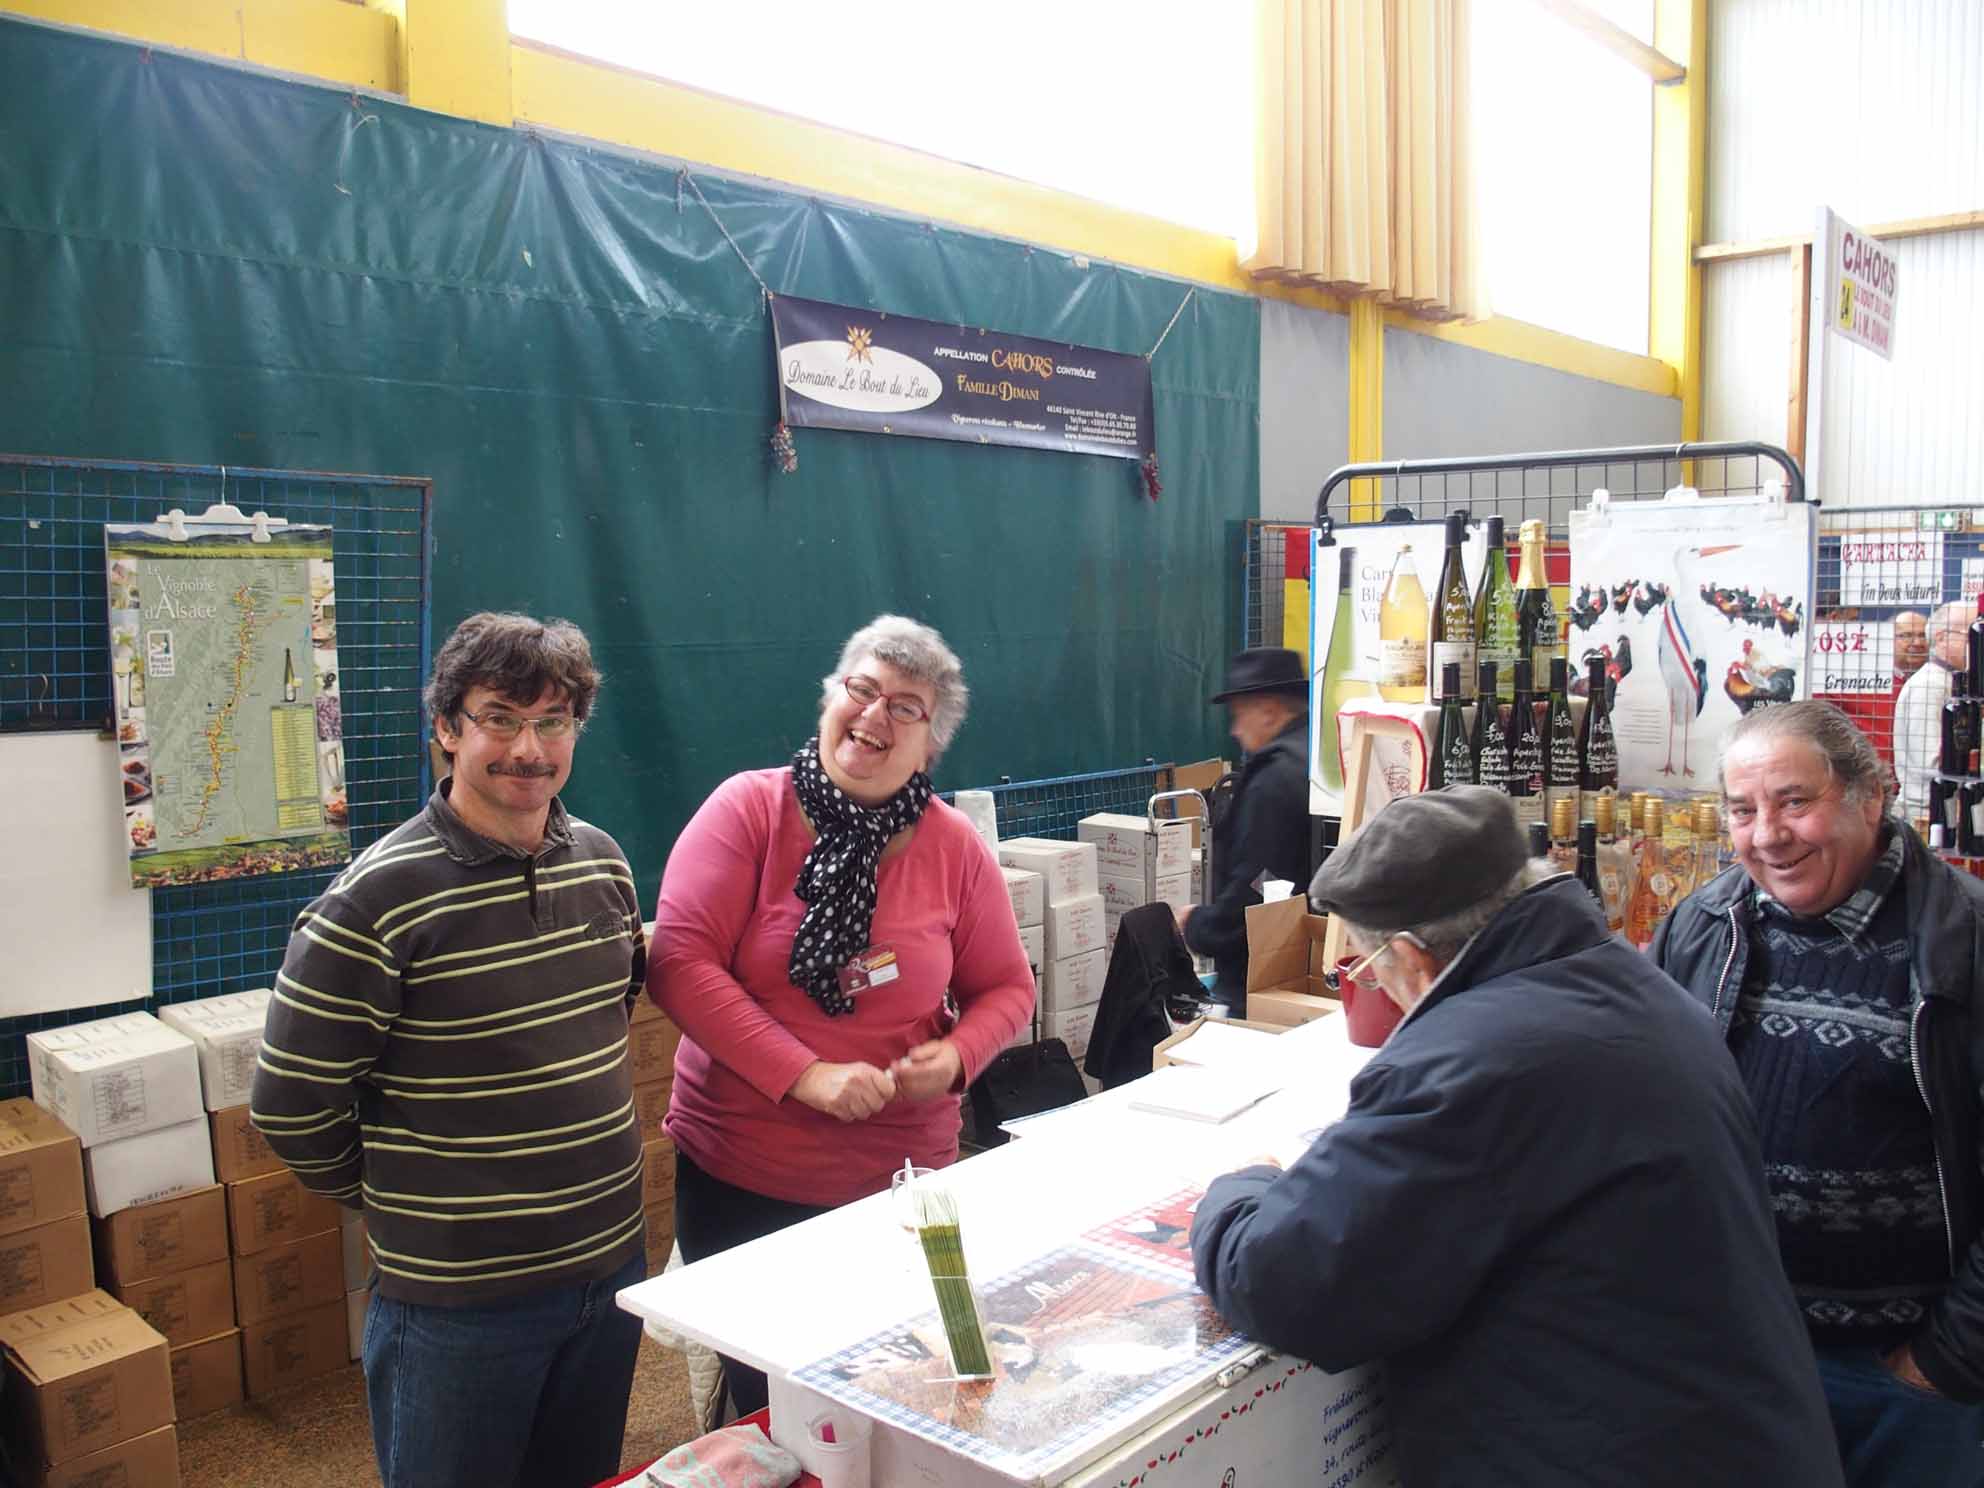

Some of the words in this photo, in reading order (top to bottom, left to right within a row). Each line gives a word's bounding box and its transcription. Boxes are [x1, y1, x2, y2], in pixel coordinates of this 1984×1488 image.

[1843, 231, 1896, 297] CAHORS
[934, 346, 988, 363] APPELLATION
[991, 348, 1054, 379] CAHORS
[1056, 364, 1097, 379] CONTRÔLÉE
[788, 359, 838, 388] Domaine
[838, 366, 857, 390] Le
[860, 368, 888, 393] Bout
[889, 376, 902, 396] du
[904, 376, 929, 400] Lieu
[956, 373, 998, 397] FAMILLE
[1842, 543, 1926, 568] GARNACHA
[158, 576, 217, 594] Vignoble
[1861, 584, 1876, 601] Vin
[1880, 583, 1900, 601] Doux
[1904, 583, 1940, 600] Naturel
[144, 592, 217, 620] d'Alsace
[1825, 673, 1892, 690] Grenache
